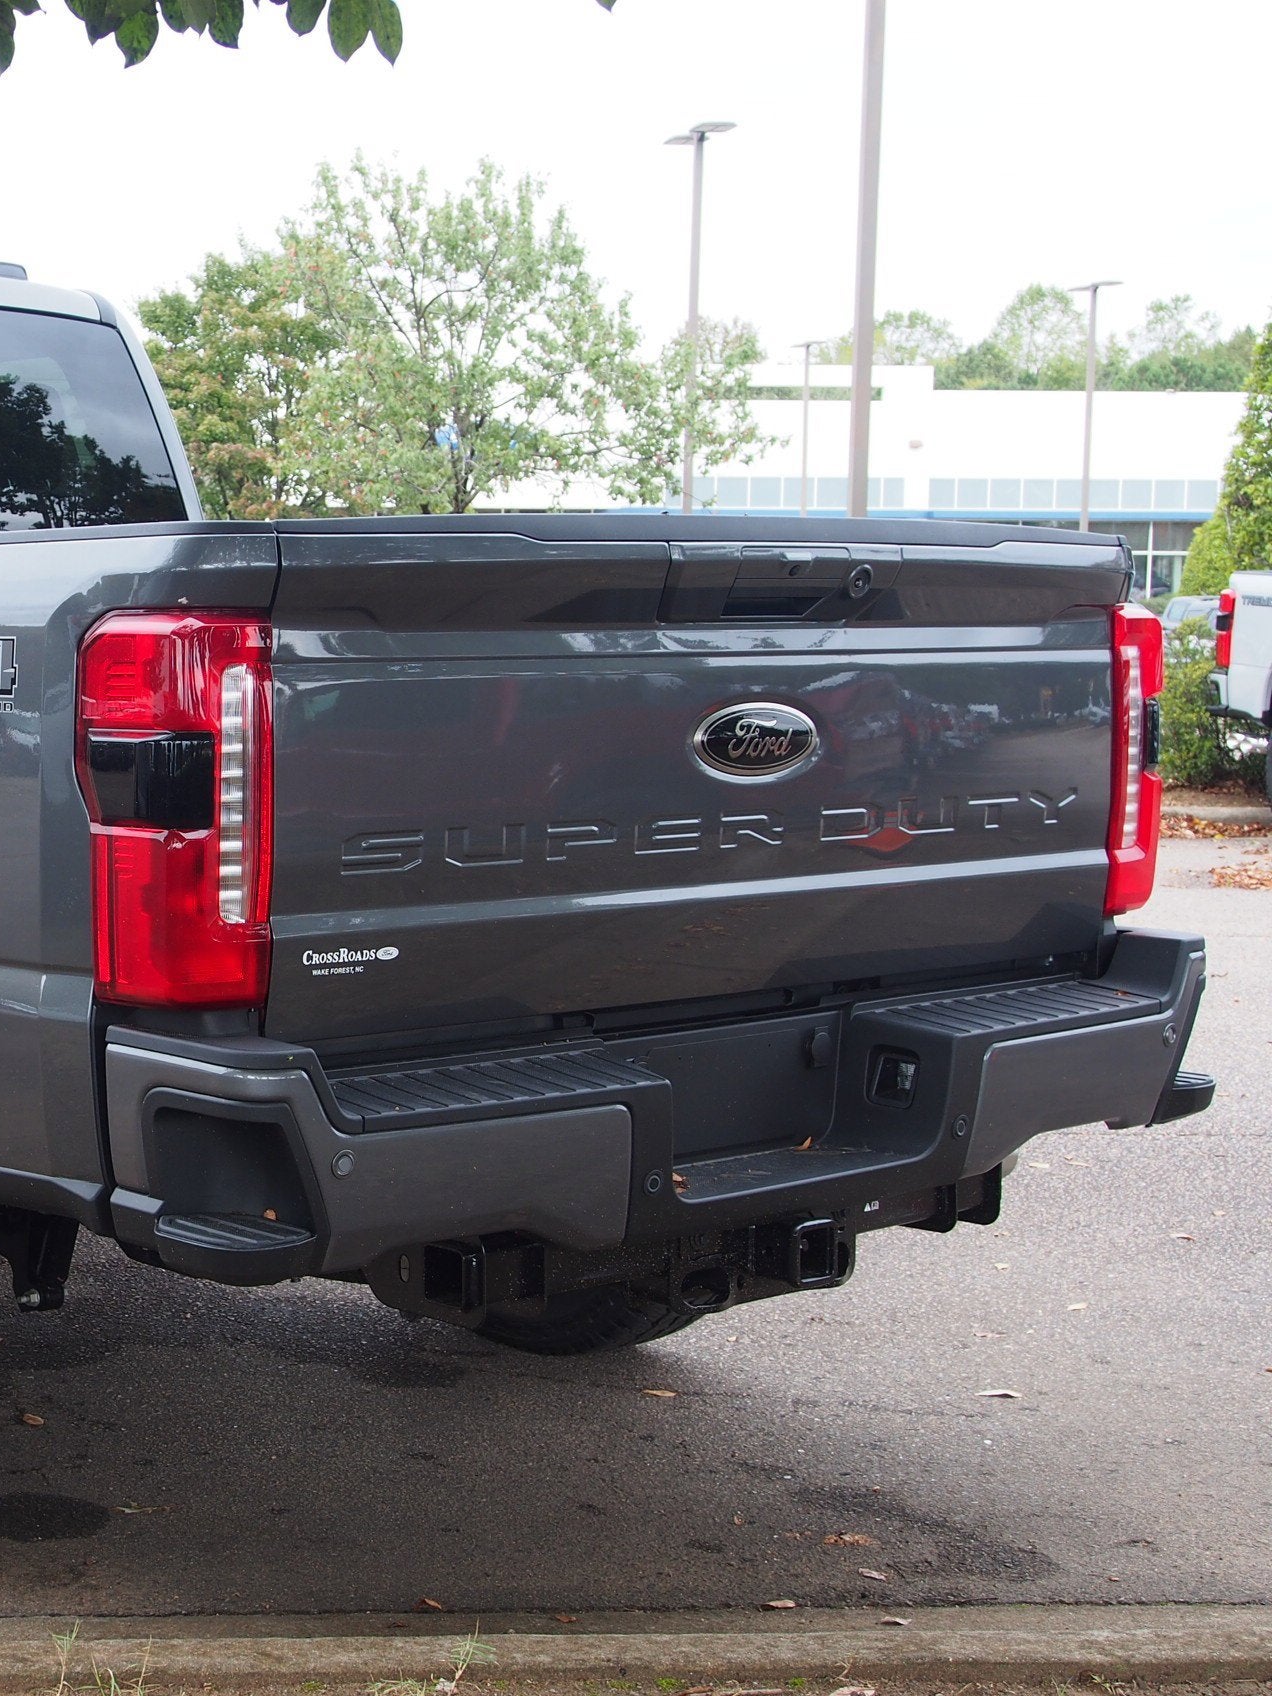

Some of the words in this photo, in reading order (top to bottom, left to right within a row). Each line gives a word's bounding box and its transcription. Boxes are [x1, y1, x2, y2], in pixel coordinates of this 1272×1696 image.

[728, 718, 793, 759] Ford
[340, 809, 785, 875] SUPER
[820, 787, 1077, 842] DUTY
[312, 968, 330, 976] WAKE
[330, 966, 355, 975] FOREST,
[355, 965, 364, 973] NC
